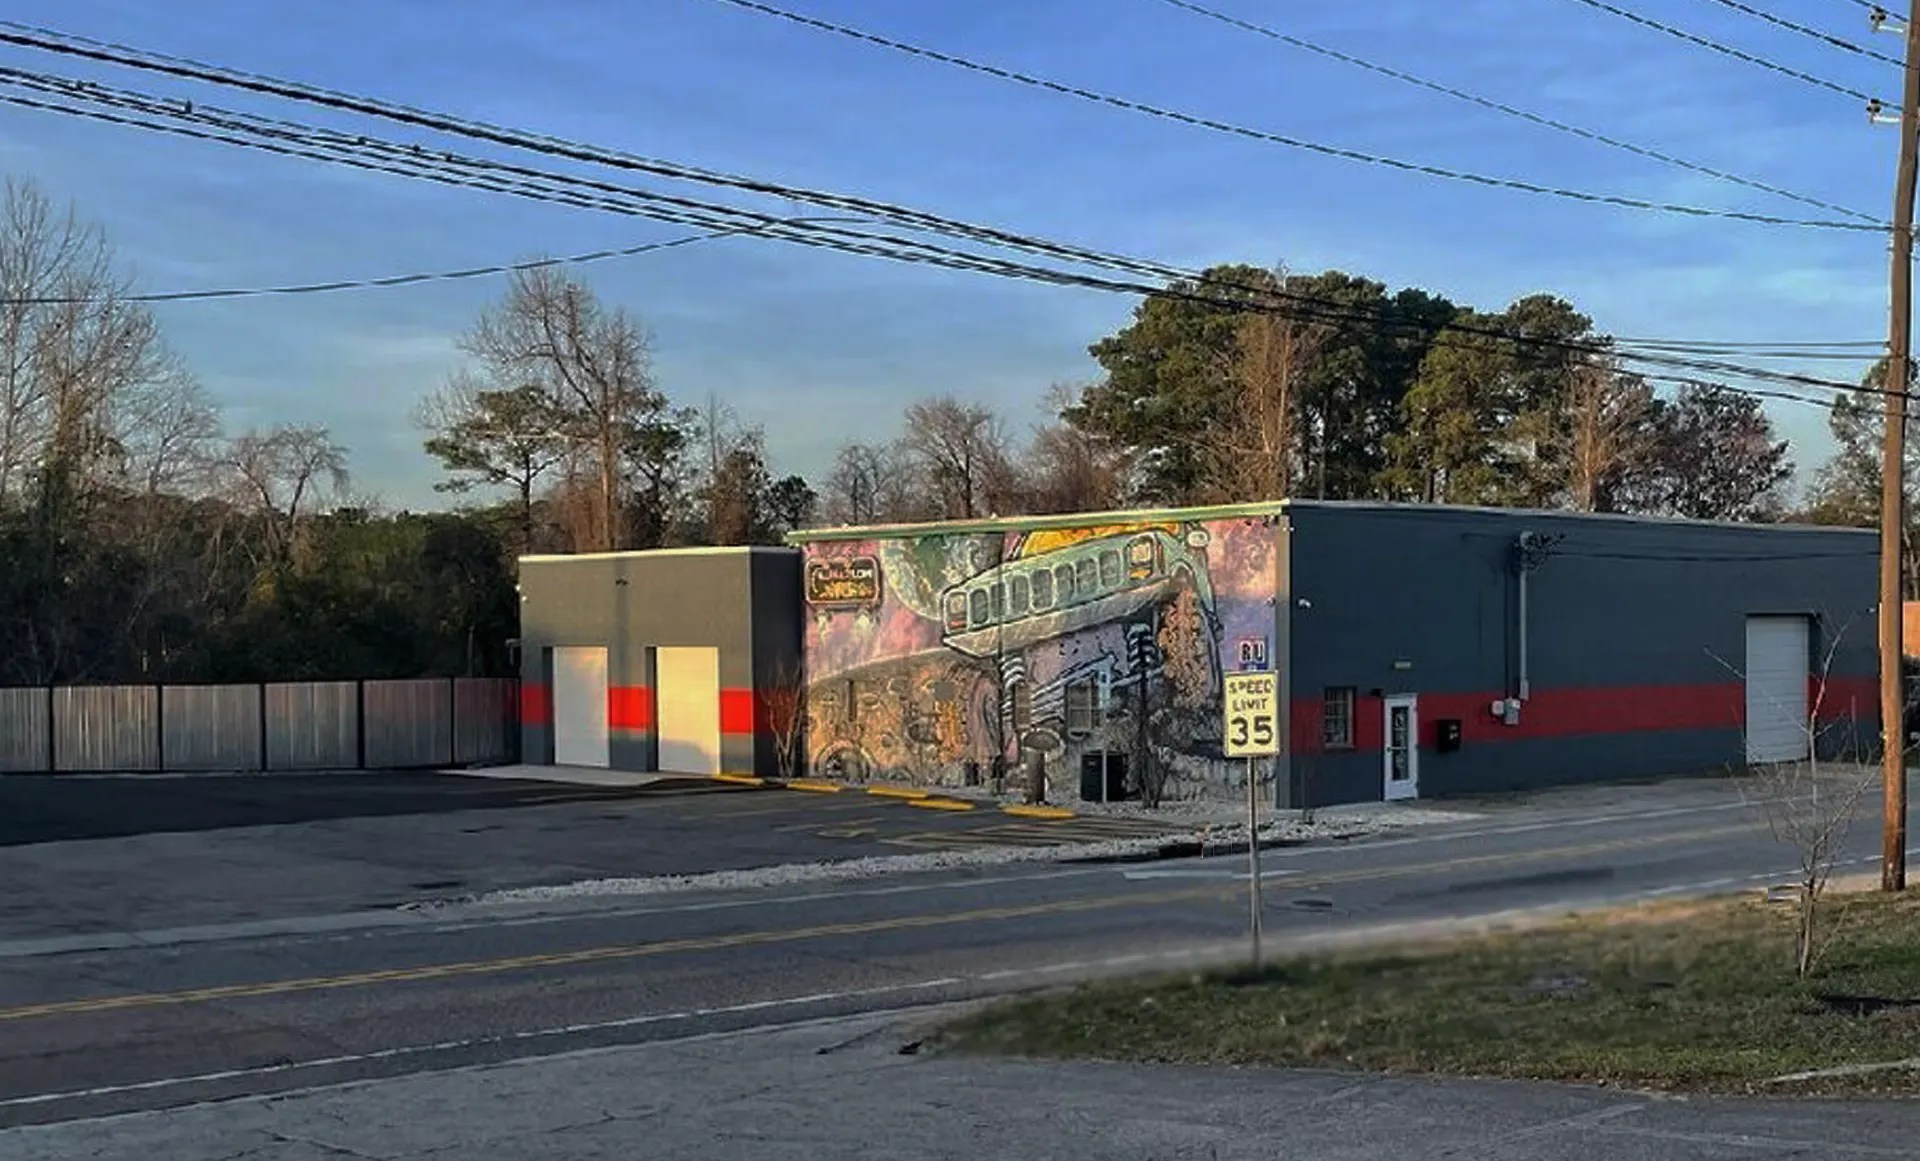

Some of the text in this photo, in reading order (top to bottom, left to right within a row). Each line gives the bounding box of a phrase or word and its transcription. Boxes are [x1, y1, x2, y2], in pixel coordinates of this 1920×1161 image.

[1229, 679, 1273, 695] SPEED
[1233, 698, 1268, 712] LIMIT
[1230, 716, 1274, 747] 35
